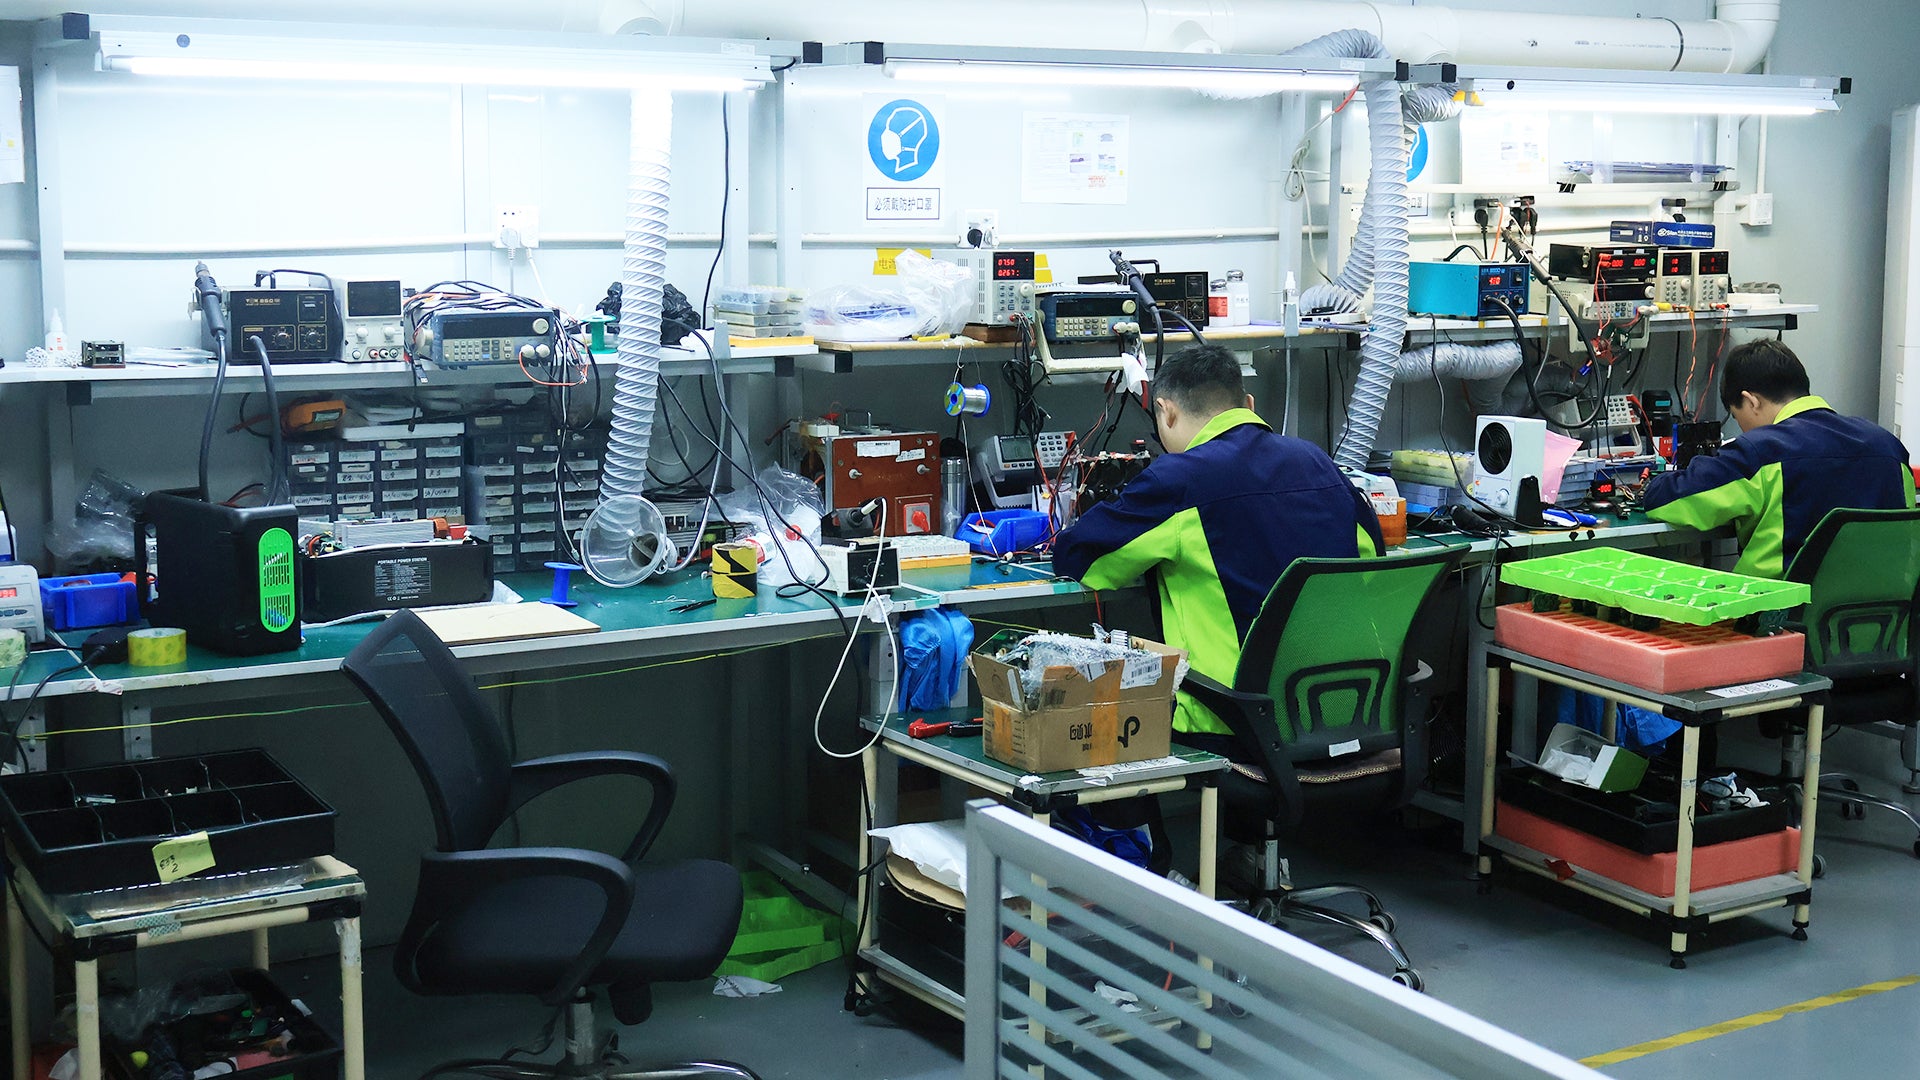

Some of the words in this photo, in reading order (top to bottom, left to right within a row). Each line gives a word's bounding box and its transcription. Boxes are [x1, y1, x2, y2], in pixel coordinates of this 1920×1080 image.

[875, 197, 932, 211] 必须戴防护口罩
